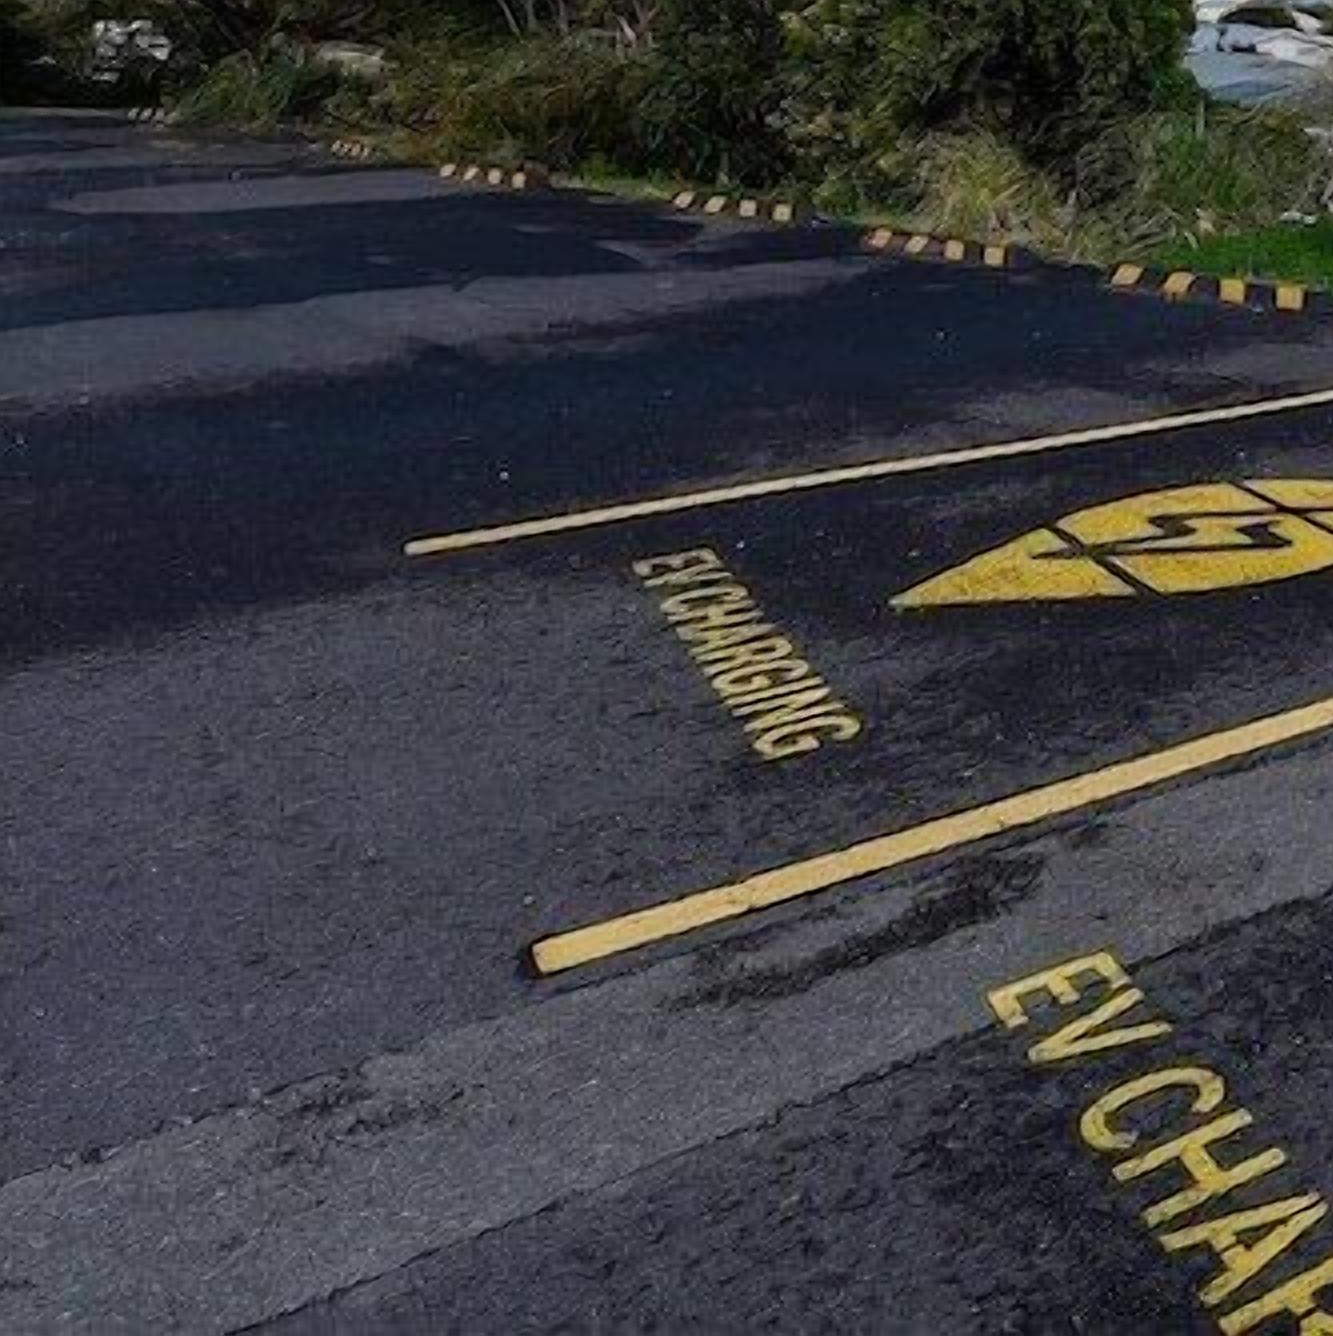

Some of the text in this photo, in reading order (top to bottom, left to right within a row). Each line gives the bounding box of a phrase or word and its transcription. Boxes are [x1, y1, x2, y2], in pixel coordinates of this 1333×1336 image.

[632, 547, 861, 761] EV CHARGING
[987, 950, 1174, 1063] EV
